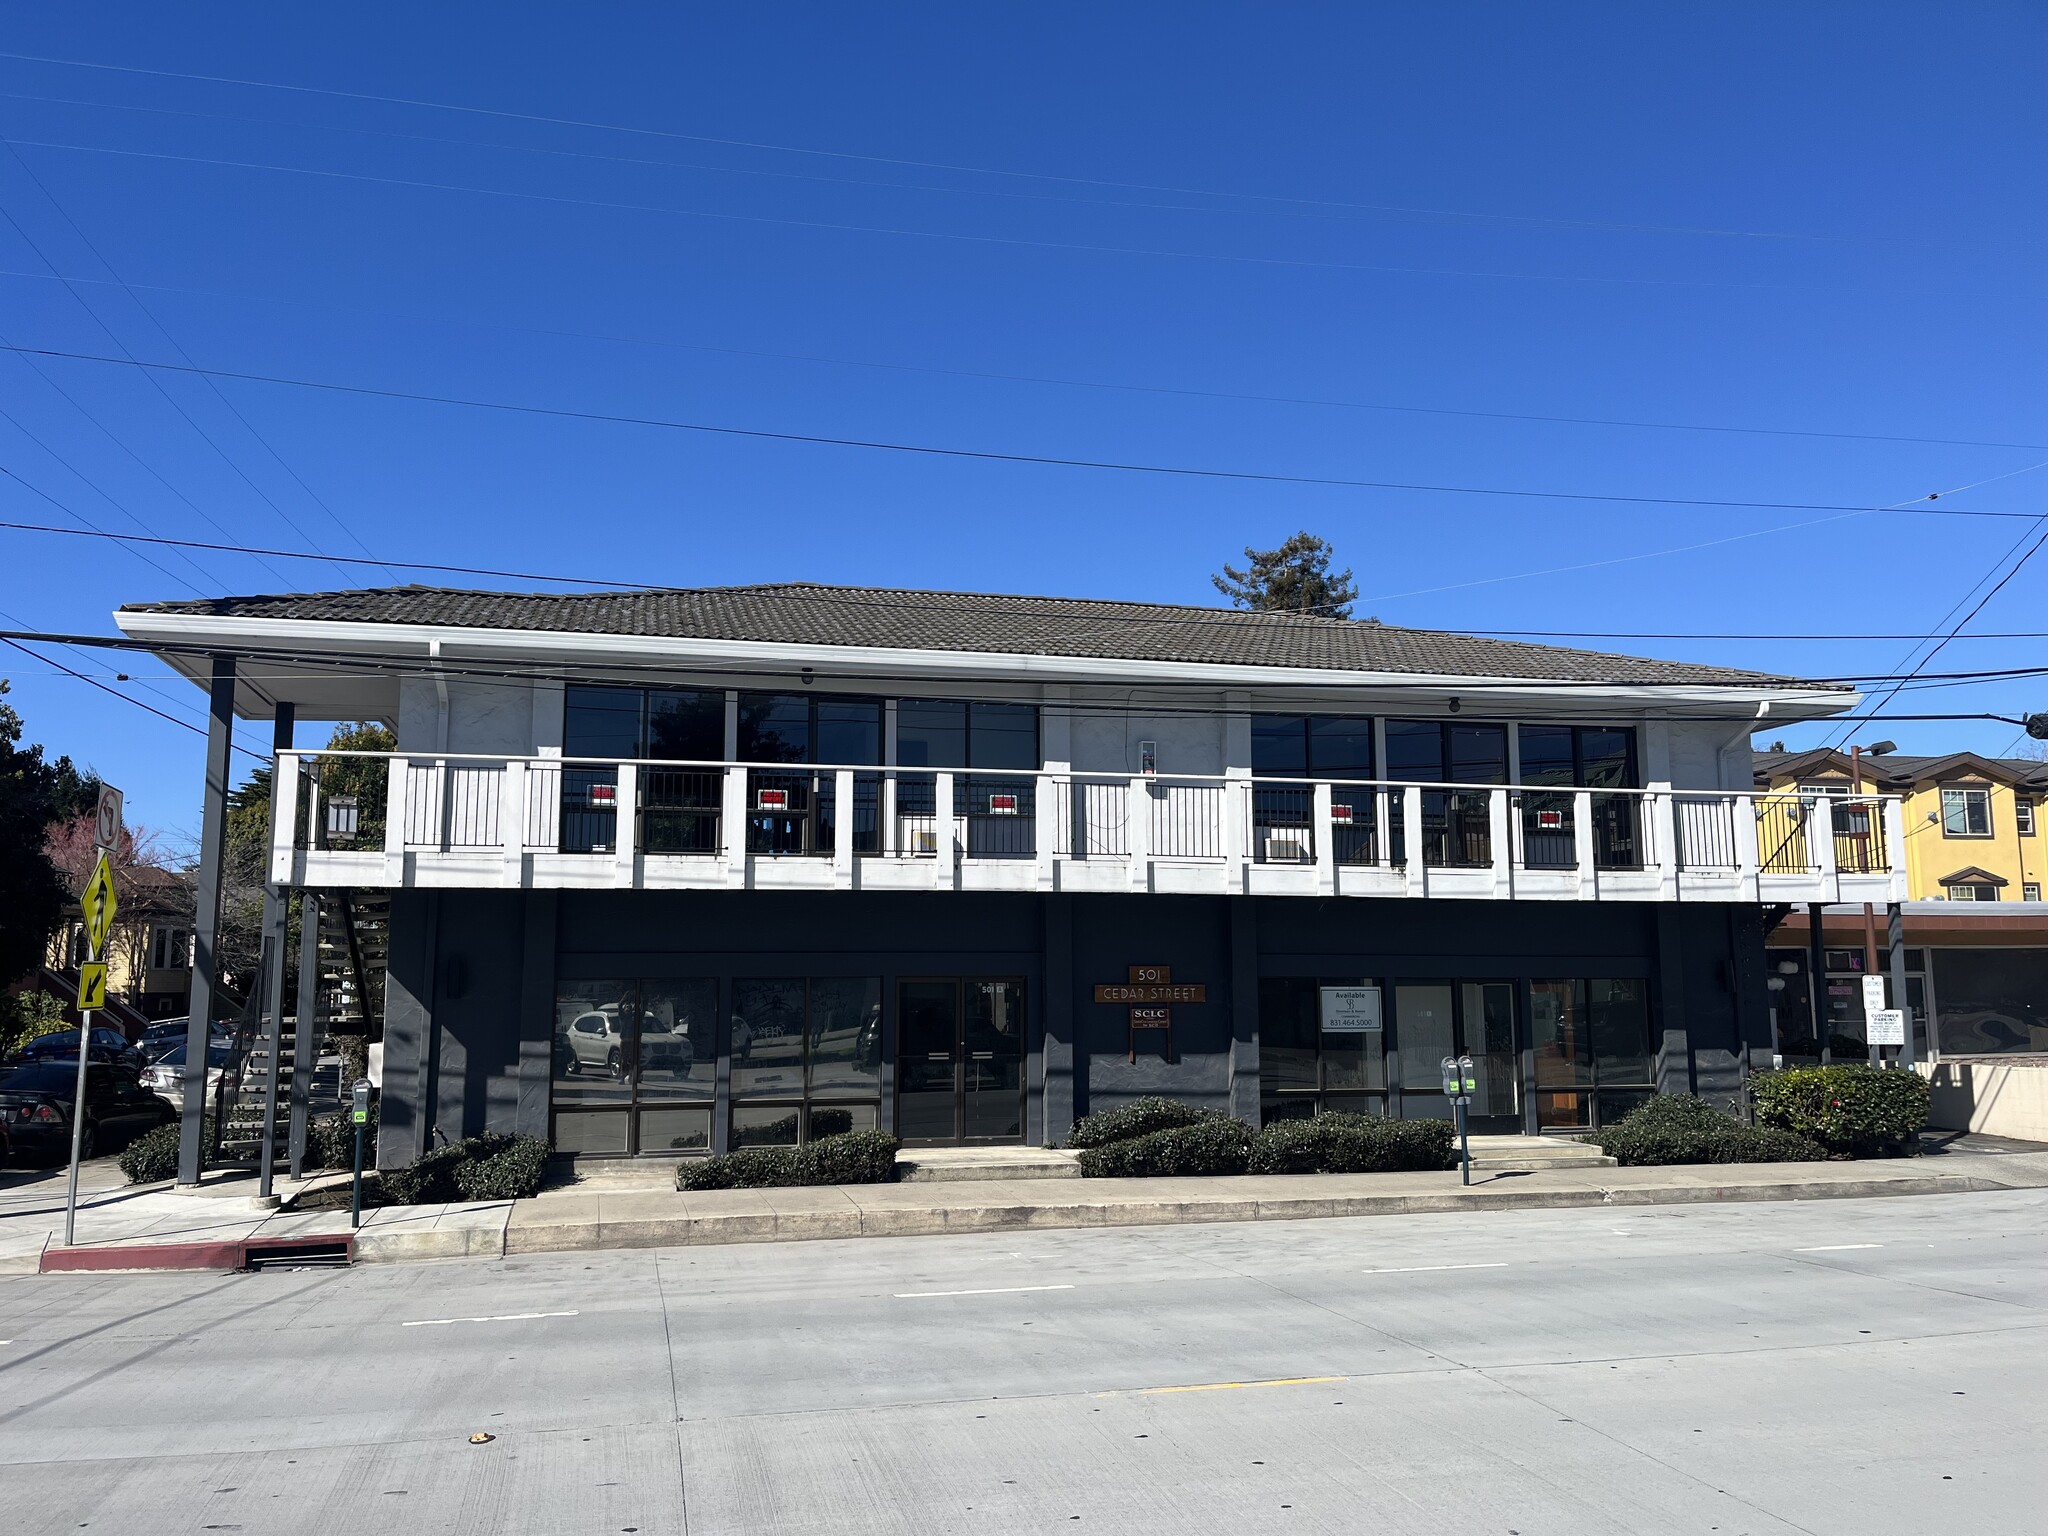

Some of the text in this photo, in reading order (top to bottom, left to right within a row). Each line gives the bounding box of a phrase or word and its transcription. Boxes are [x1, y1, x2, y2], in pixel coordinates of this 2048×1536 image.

[1138, 969, 1160, 981] 501
[1103, 988, 1196, 999] CEDAR STREET
[1134, 1010, 1165, 1018] SCLC
